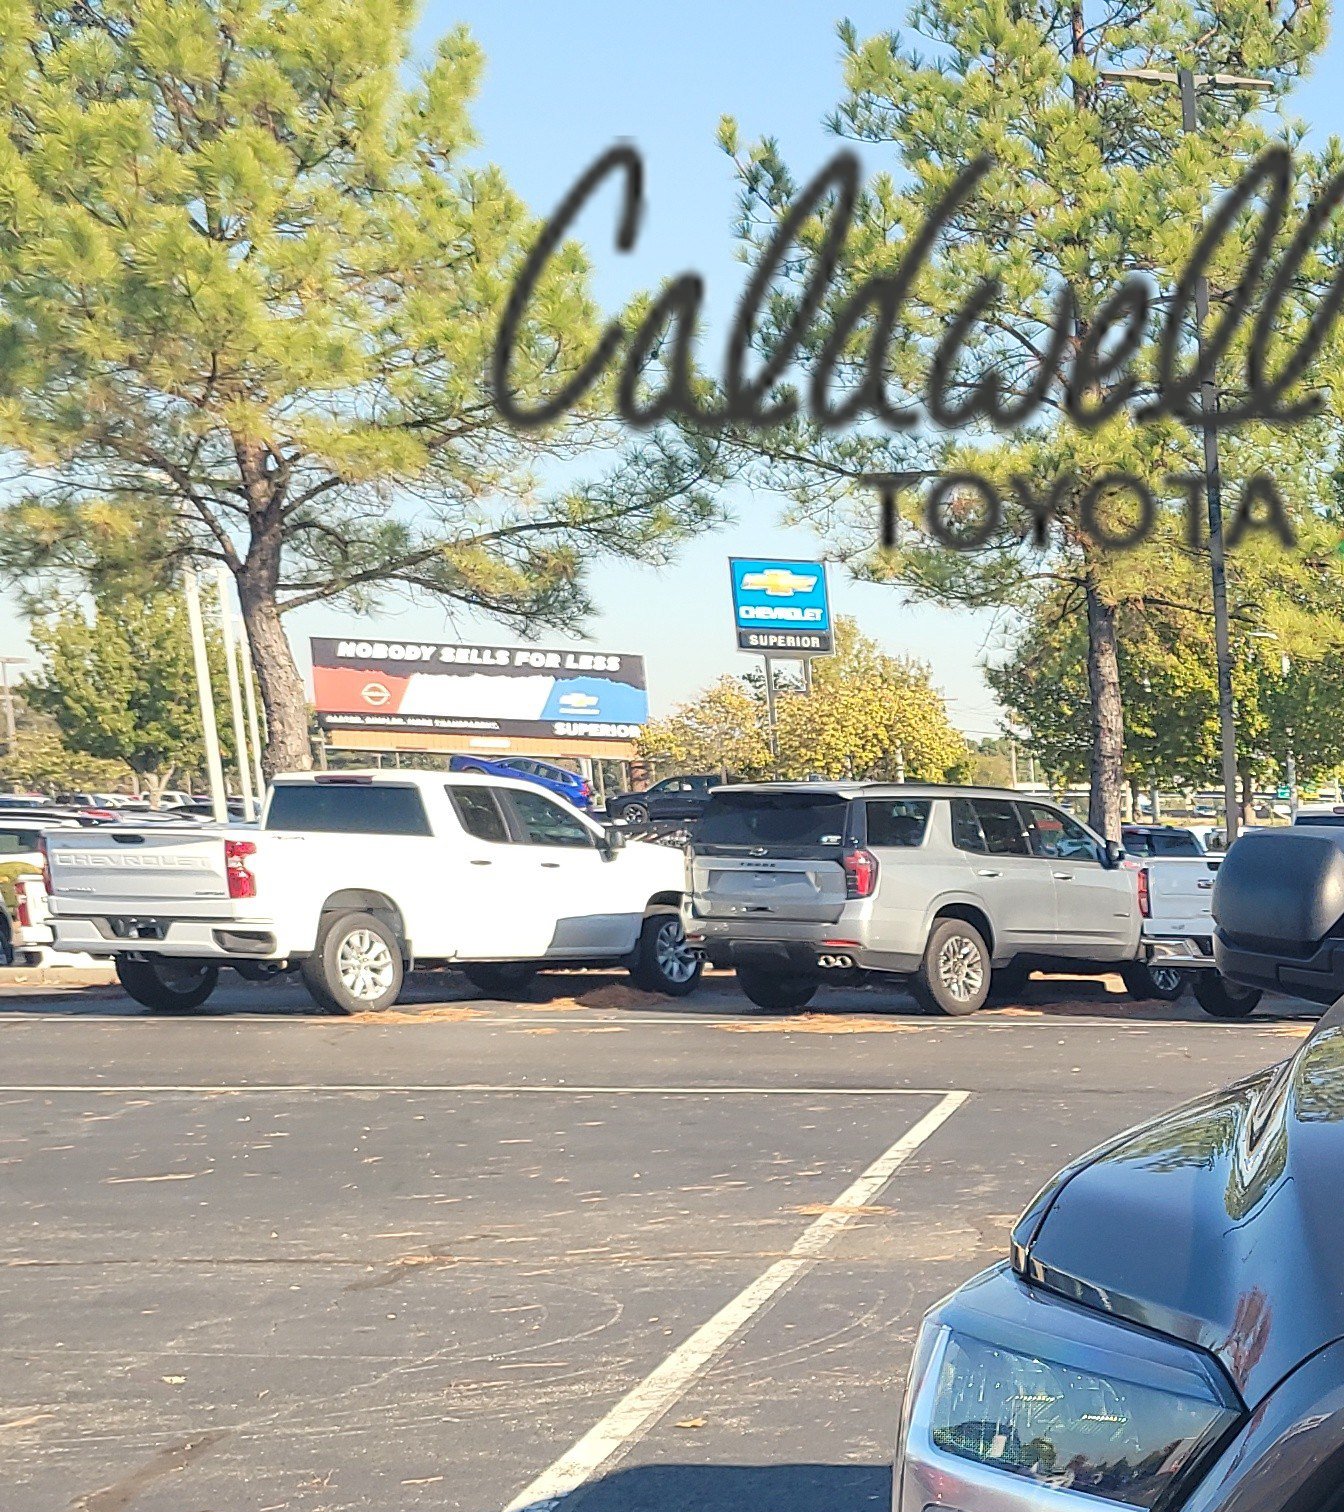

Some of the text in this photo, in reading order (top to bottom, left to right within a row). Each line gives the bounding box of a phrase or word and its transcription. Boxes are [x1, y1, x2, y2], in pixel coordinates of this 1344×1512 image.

[739, 605, 823, 621] CHEVROLET
[749, 634, 820, 647] SUPERIOR
[337, 641, 621, 672] NOBODY SELLS FOR LESS
[554, 722, 642, 739] SUPERIOR
[56, 853, 211, 868] CHEVROLET
